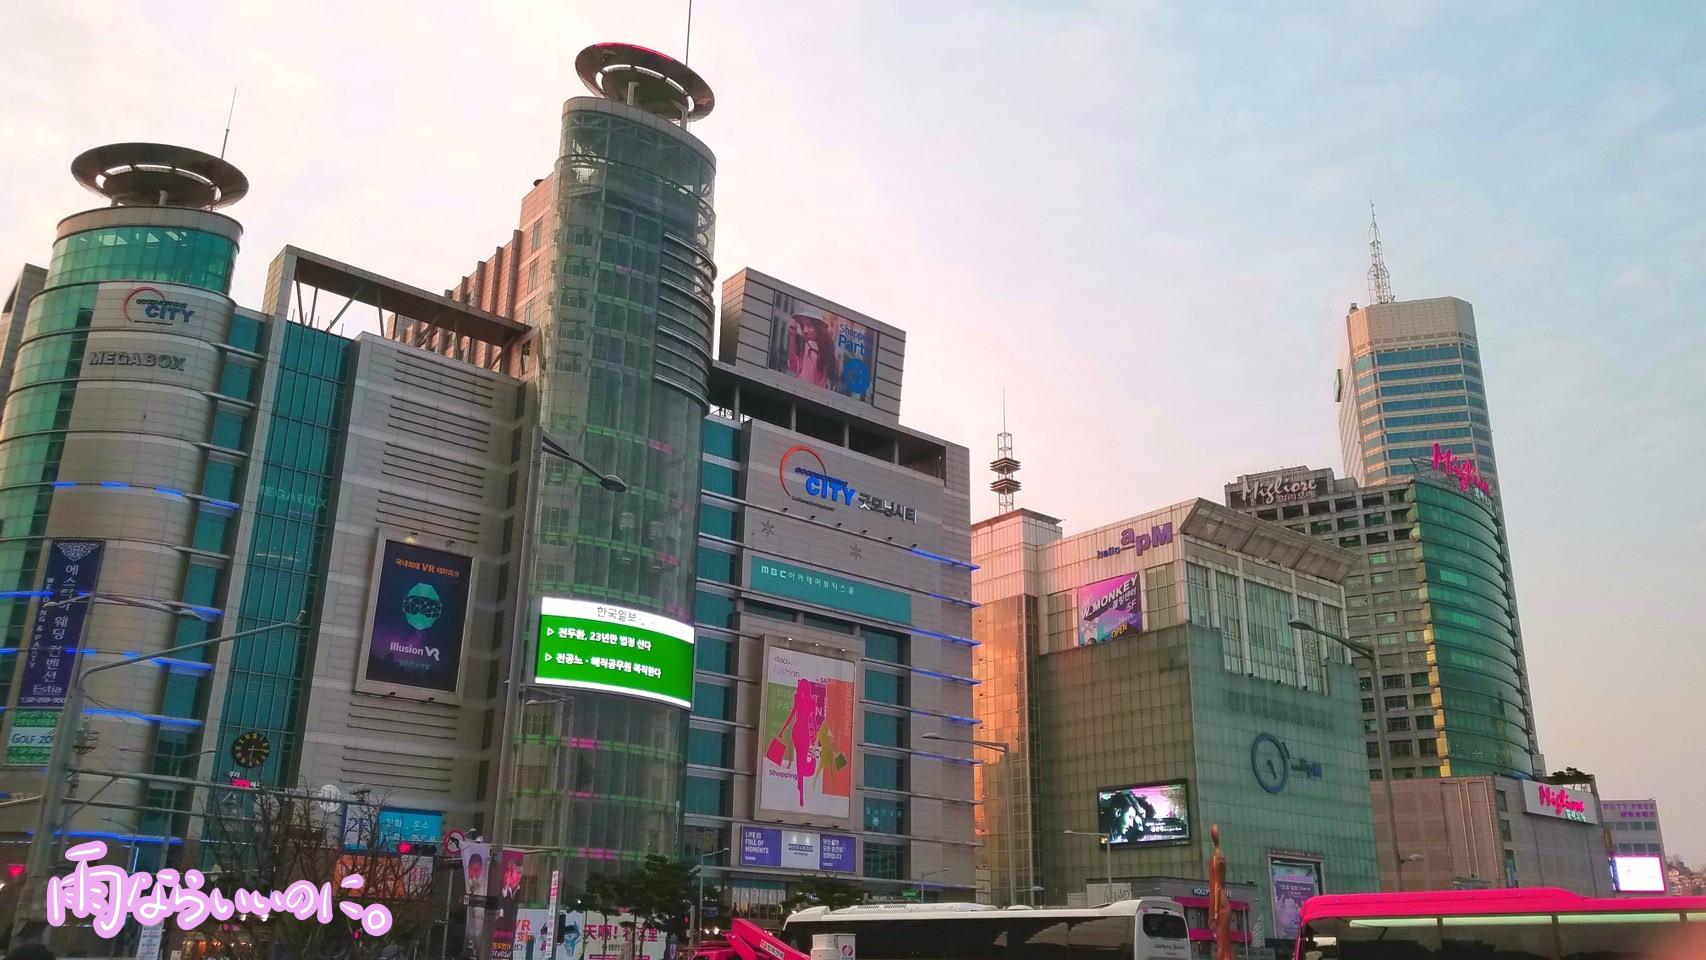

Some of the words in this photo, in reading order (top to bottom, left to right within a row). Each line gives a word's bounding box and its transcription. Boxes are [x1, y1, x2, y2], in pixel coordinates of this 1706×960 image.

[145, 303, 194, 323] CITY
[89, 351, 186, 371] MEGABOX
[1241, 475, 1317, 504] Migliore
[806, 475, 856, 506] CITY
[858, 492, 917, 525] 굿모닝시티
[1097, 546, 1120, 559] hello
[422, 562, 435, 573] VR
[38, 577, 55, 623] WEDNG
[597, 606, 637, 623] 한국일보
[52, 616, 69, 640] 웨딩
[1112, 622, 1128, 639] OPEN
[590, 631, 618, 645] 23년만
[389, 641, 424, 656] illusion
[425, 645, 440, 662] VR
[33, 684, 62, 694] Estia
[768, 769, 798, 781] Shopping
[745, 846, 769, 854] MOMENTS
